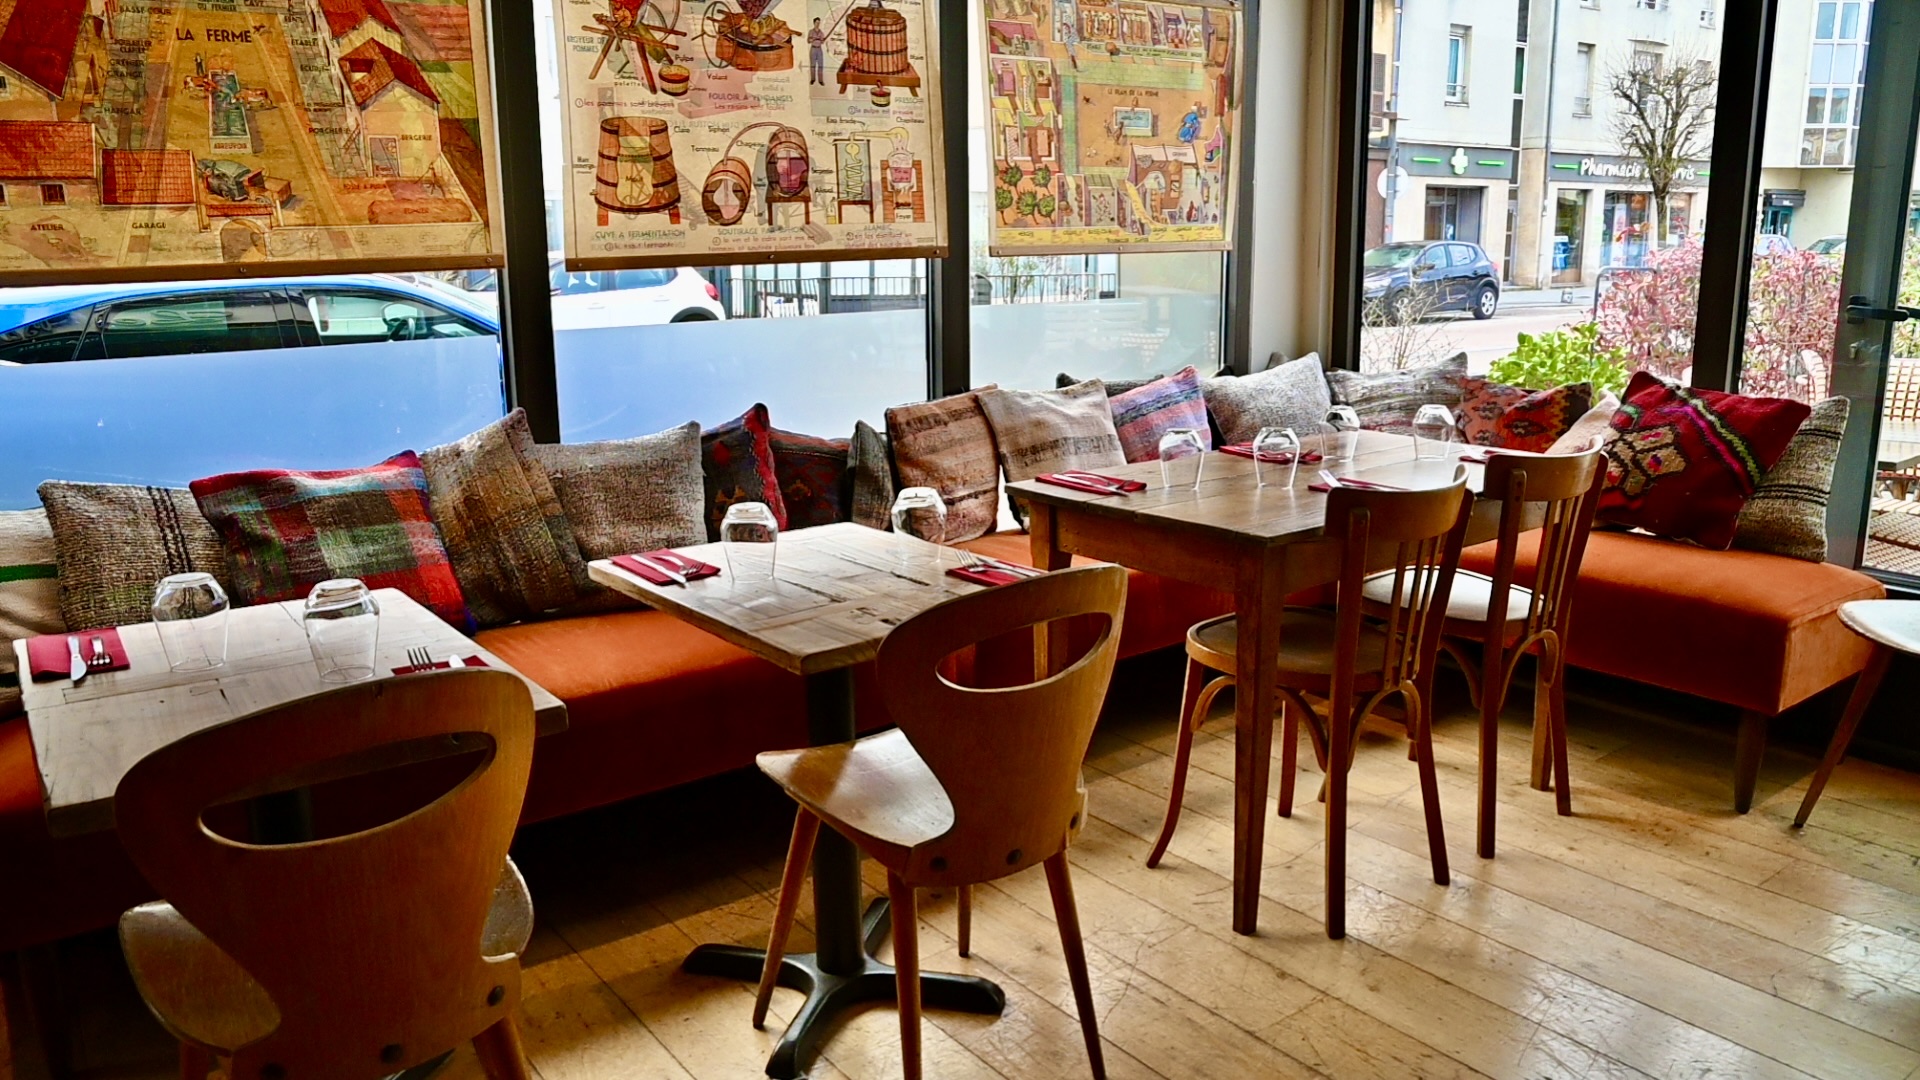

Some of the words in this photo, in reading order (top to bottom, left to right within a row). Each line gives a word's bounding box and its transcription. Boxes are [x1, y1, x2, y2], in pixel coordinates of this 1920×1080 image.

[175, 28, 195, 41] LA
[206, 28, 252, 43] FERME
[103, 107, 142, 116] HANGAR
[1580, 157, 1641, 178] Pharmacie
[30, 223, 65, 232] ATELIER
